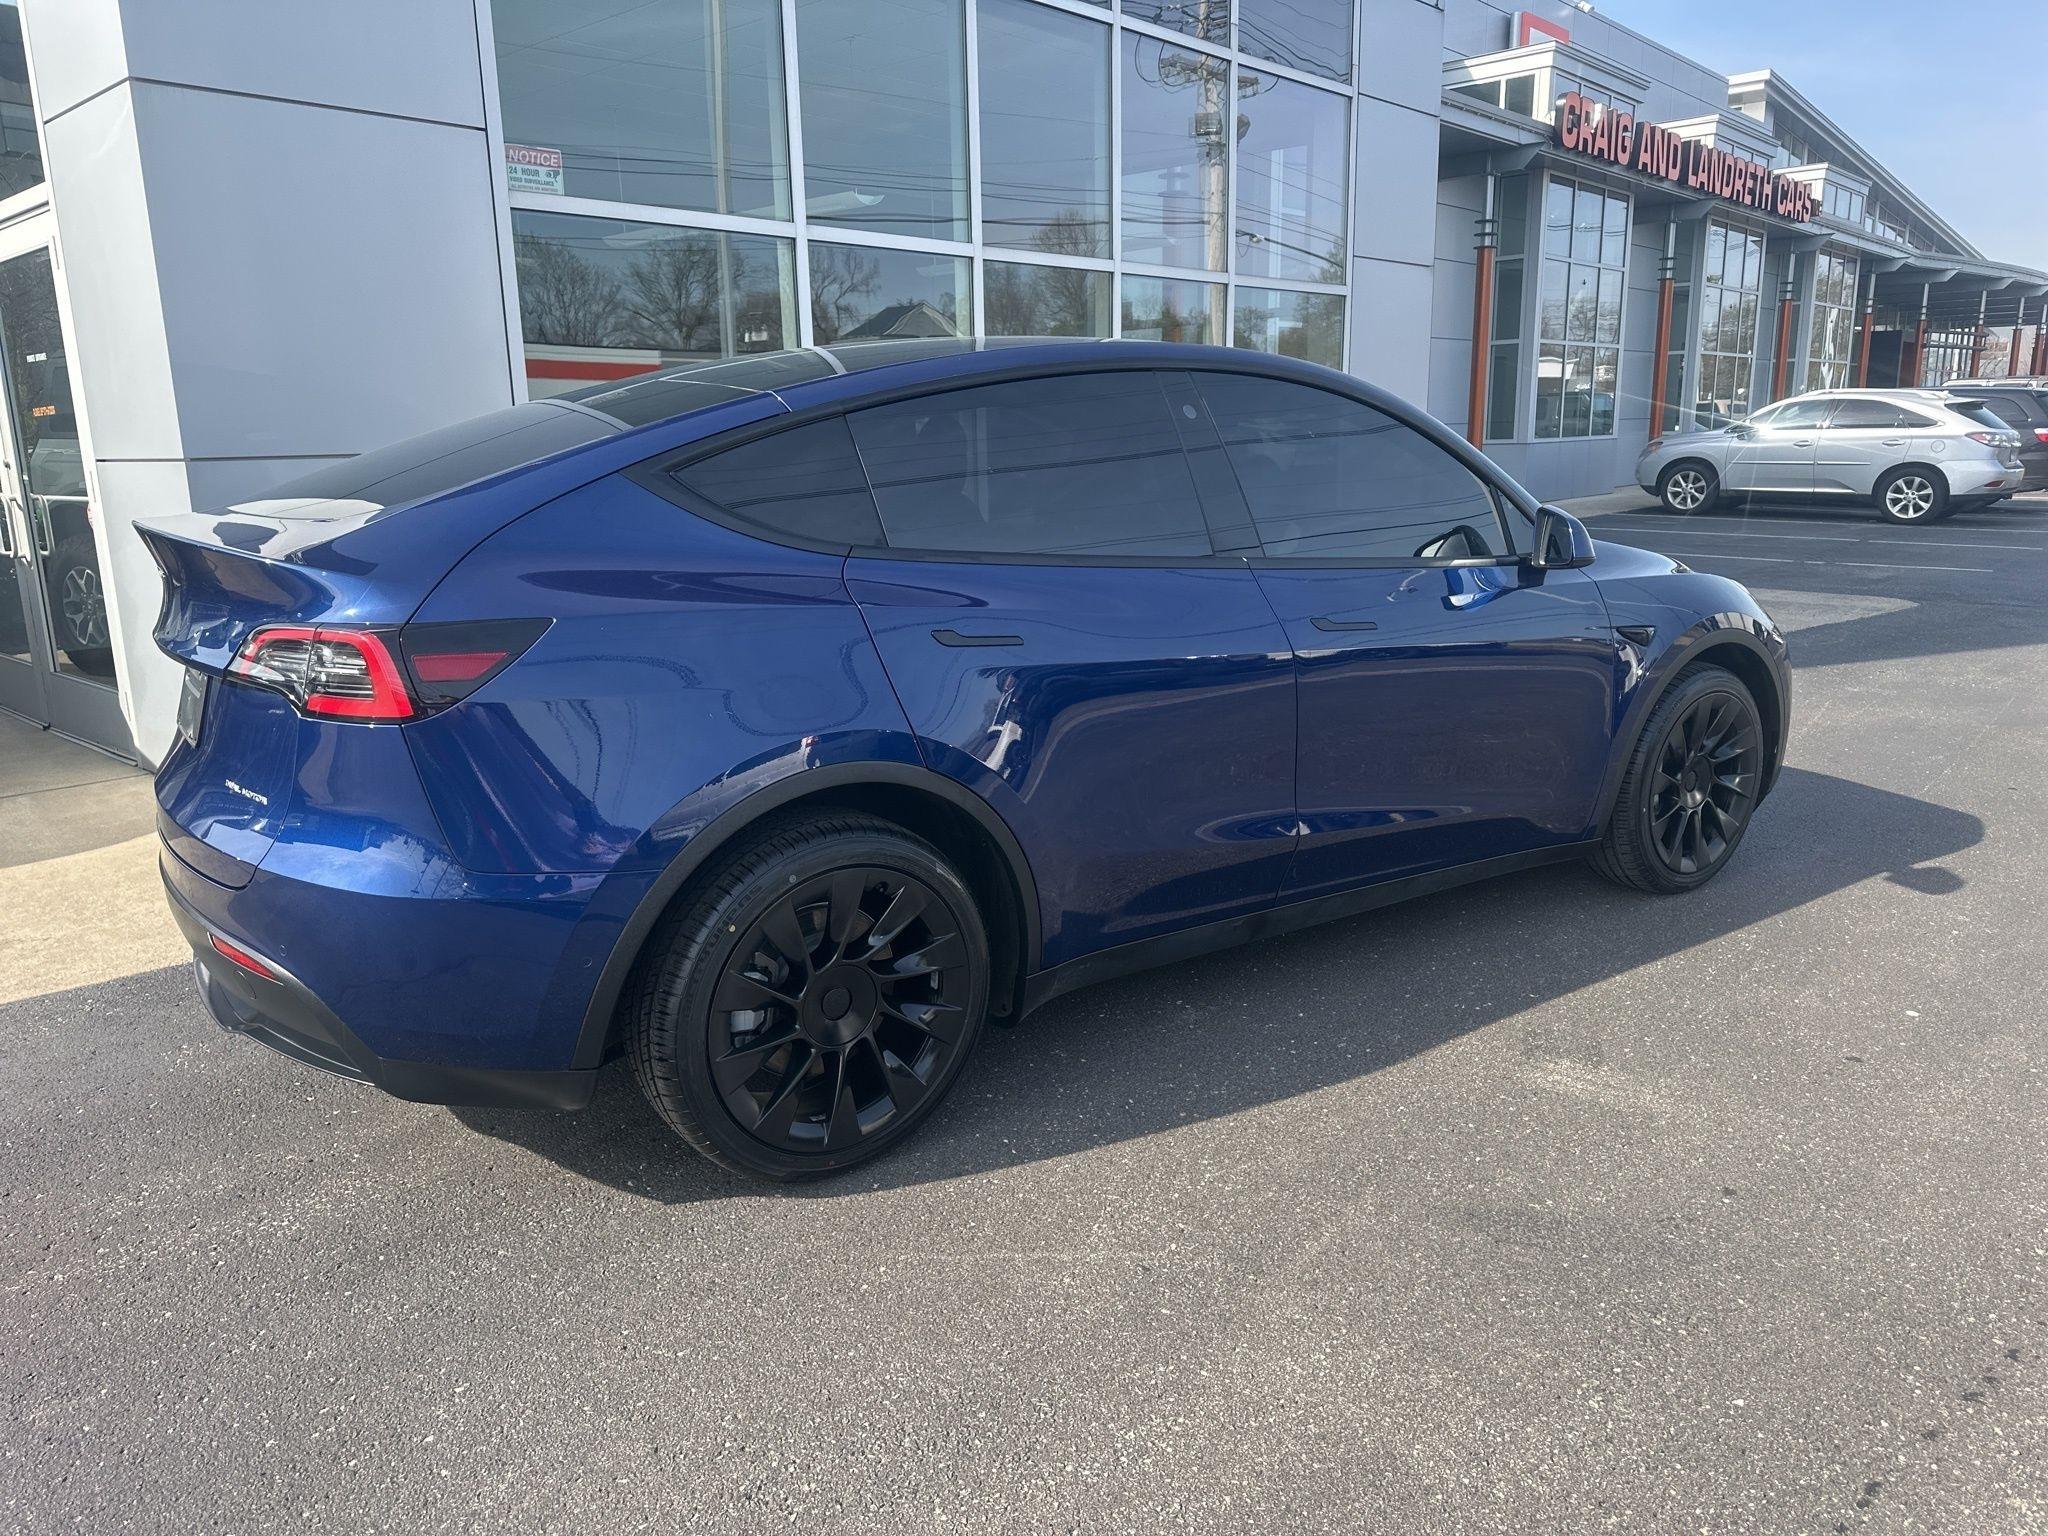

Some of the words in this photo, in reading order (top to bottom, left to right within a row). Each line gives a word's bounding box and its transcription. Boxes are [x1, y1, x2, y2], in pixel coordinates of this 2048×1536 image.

[509, 149, 558, 166] NOTICE
[1560, 91, 1633, 165] CRAIG
[1638, 121, 1682, 181] AND
[1687, 139, 1773, 211] LANDRETH
[1775, 174, 1813, 223] CARS
[508, 166, 517, 174] 24
[521, 167, 540, 177] HOUR
